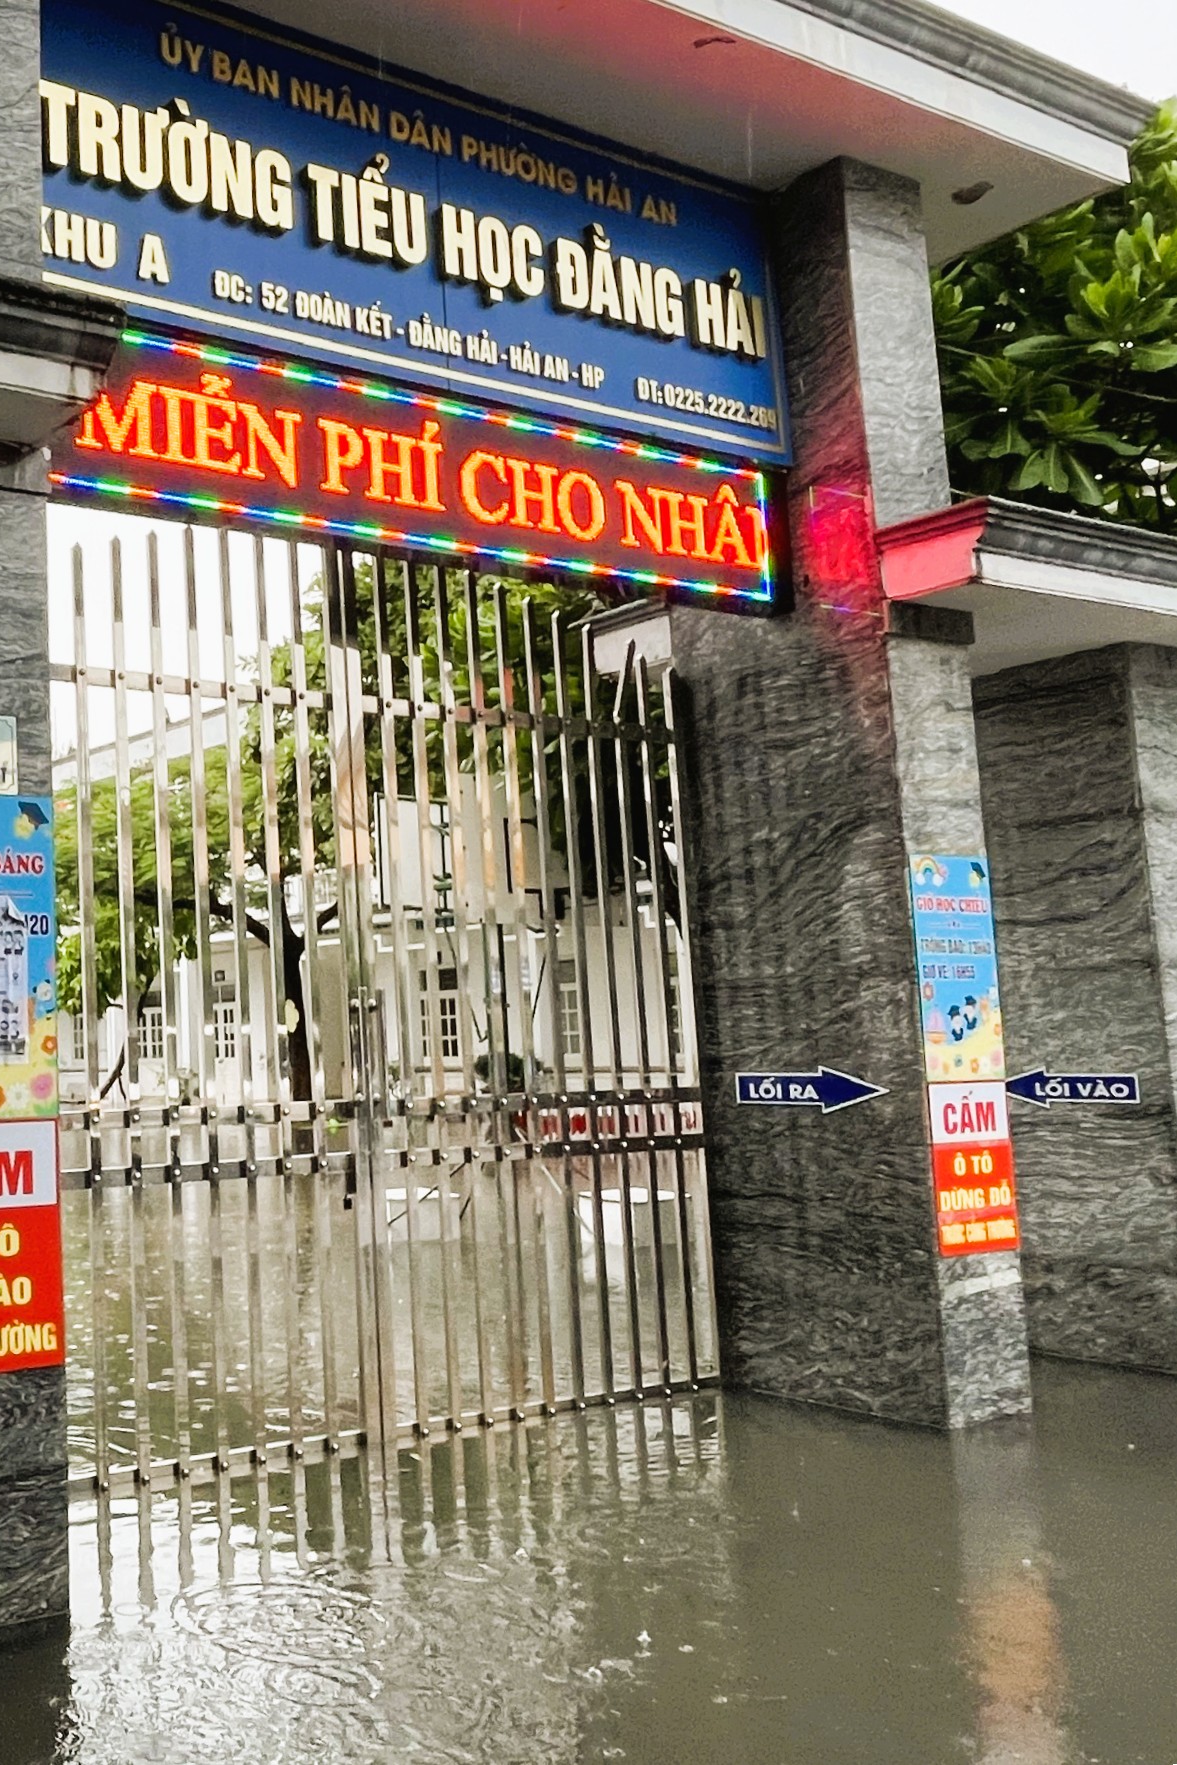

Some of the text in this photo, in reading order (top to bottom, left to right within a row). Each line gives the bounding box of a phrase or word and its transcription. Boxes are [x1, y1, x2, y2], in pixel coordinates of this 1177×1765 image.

[161, 22, 678, 227] ỦY BAN NHÂN DÂN PHƯỜNG HẢI AN
[39, 79, 767, 359] TRƯỜNG TIỂU HỌC ĐẰNG HẢI
[138, 233, 170, 284] A
[214, 270, 254, 304] ĐC:
[261, 281, 290, 314] 52
[295, 290, 352, 329] ĐOÀN
[355, 300, 394, 340] KẾT
[408, 312, 463, 357] ĐẰNG
[466, 328, 499, 365] HẢI
[509, 340, 541, 376] HẢI
[543, 354, 570, 383] AN
[581, 362, 605, 390] HP
[74, 372, 302, 489] MIỄN
[317, 416, 447, 513] PHÍ
[460, 450, 606, 543] CHO
[748, 1077, 820, 1100] LỐI RA
[1034, 1077, 1130, 1099] LỐI VÀO
[942, 1090, 997, 1135] CẤM
[953, 1150, 994, 1177] Ô TÔ
[939, 1185, 986, 1212] DỪNG
